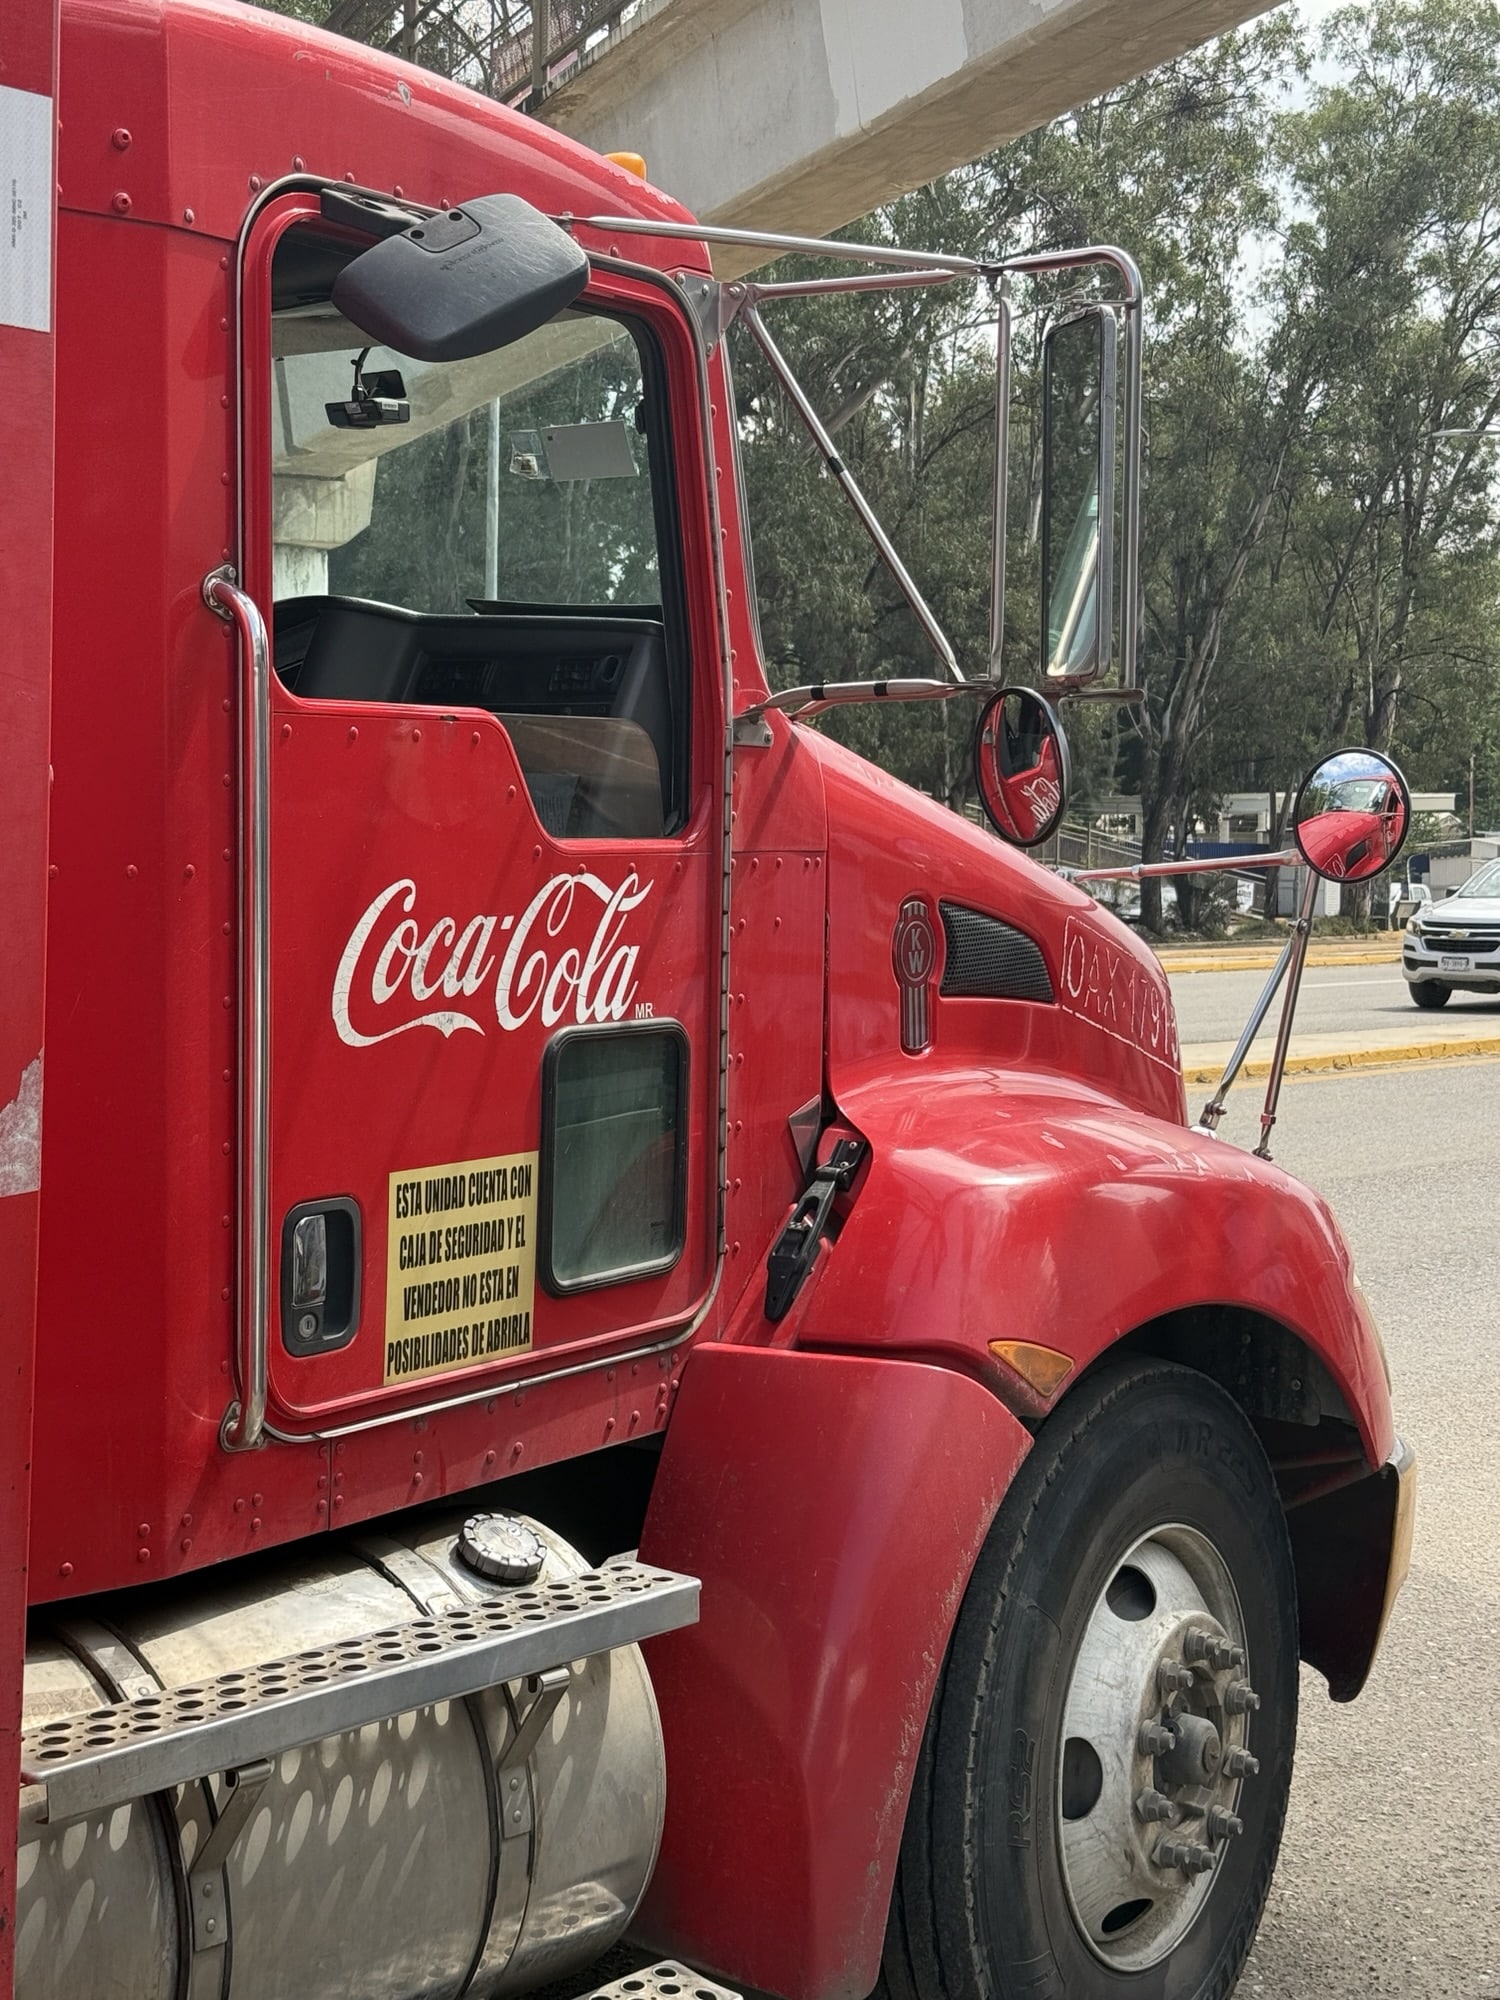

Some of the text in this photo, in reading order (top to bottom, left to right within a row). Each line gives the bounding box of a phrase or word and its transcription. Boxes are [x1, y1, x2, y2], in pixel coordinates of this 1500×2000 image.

[331, 872, 654, 1047] Coca-Cola
[635, 1002, 653, 1019] MR
[396, 1164, 532, 1219] ESTA UNIDAD CUENTA CON
[399, 1215, 525, 1271] CAJA DE SEGURIDAD Y EL
[404, 1265, 519, 1321] VENDEDOR NO ESTA EN
[387, 1312, 530, 1377] POSIBILIDADES DE ABRIRLA
